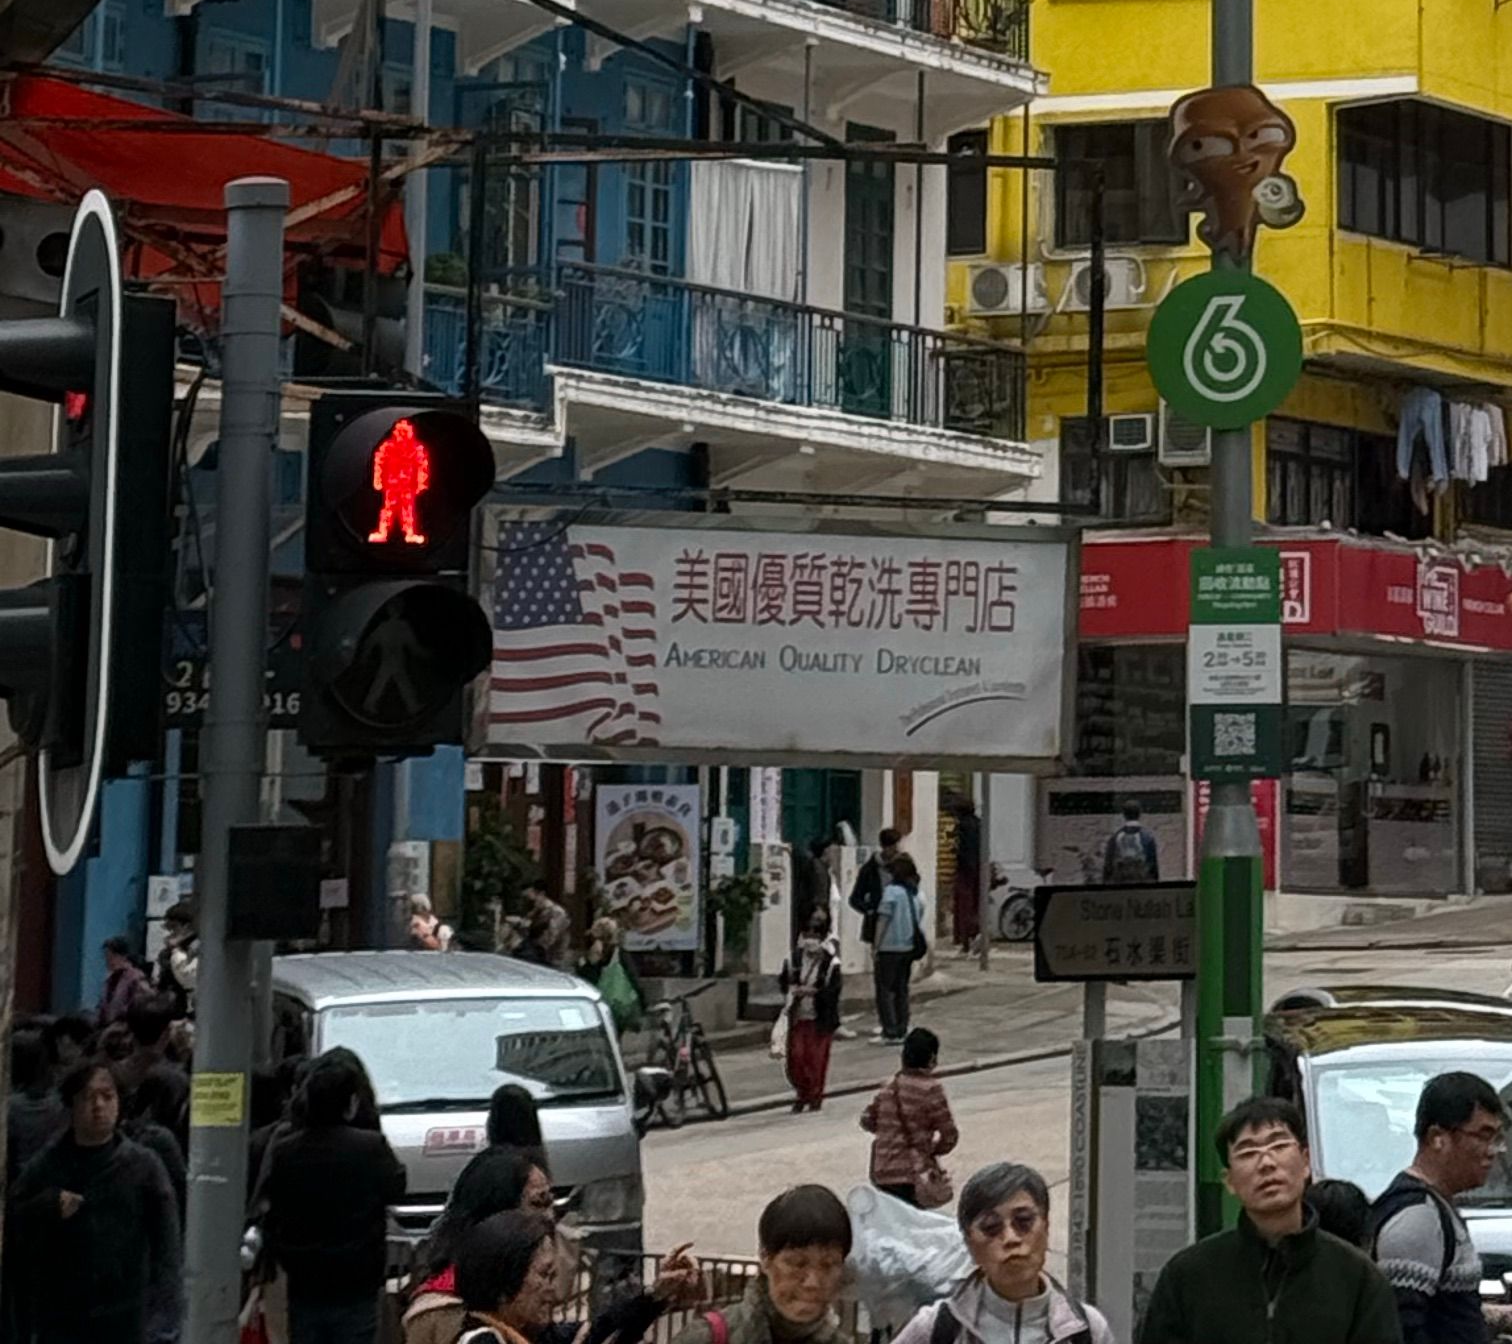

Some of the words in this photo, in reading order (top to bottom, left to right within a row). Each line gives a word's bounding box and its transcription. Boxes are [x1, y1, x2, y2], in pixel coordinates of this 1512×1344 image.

[671, 548, 1018, 634] 美國優質乾洗專門店
[664, 641, 767, 670] AMERICAN
[779, 644, 863, 673] QUALITY
[876, 647, 981, 677] DRYCLEAN
[1176, 894, 1196, 918] La
[1104, 935, 1190, 966] 石水渠街
